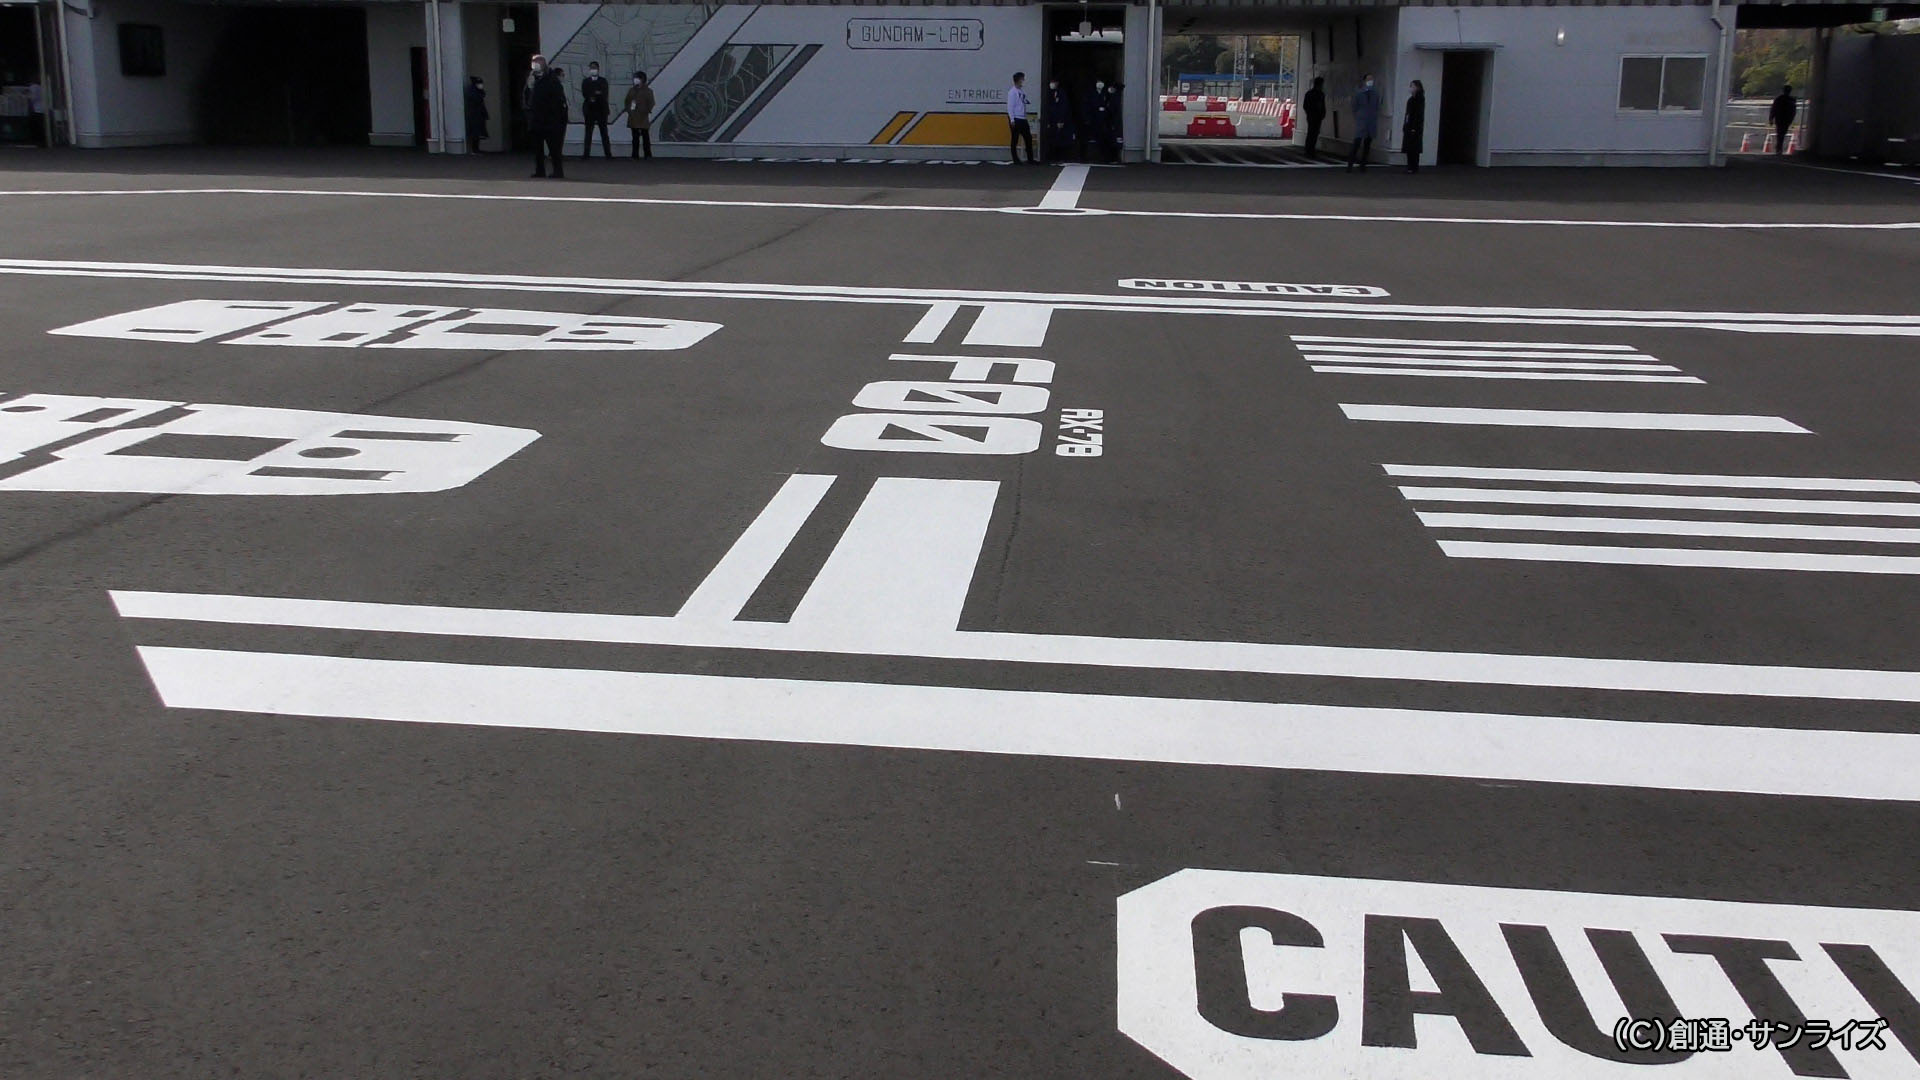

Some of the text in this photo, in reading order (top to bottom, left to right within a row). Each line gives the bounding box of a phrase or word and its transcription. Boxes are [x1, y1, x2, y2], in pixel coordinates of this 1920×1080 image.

[861, 25, 970, 43] GUNDAM-LAB
[948, 89, 1003, 100] ENTRANCE
[1134, 280, 1372, 295] CAUTION
[1055, 408, 1104, 457] RX-78
